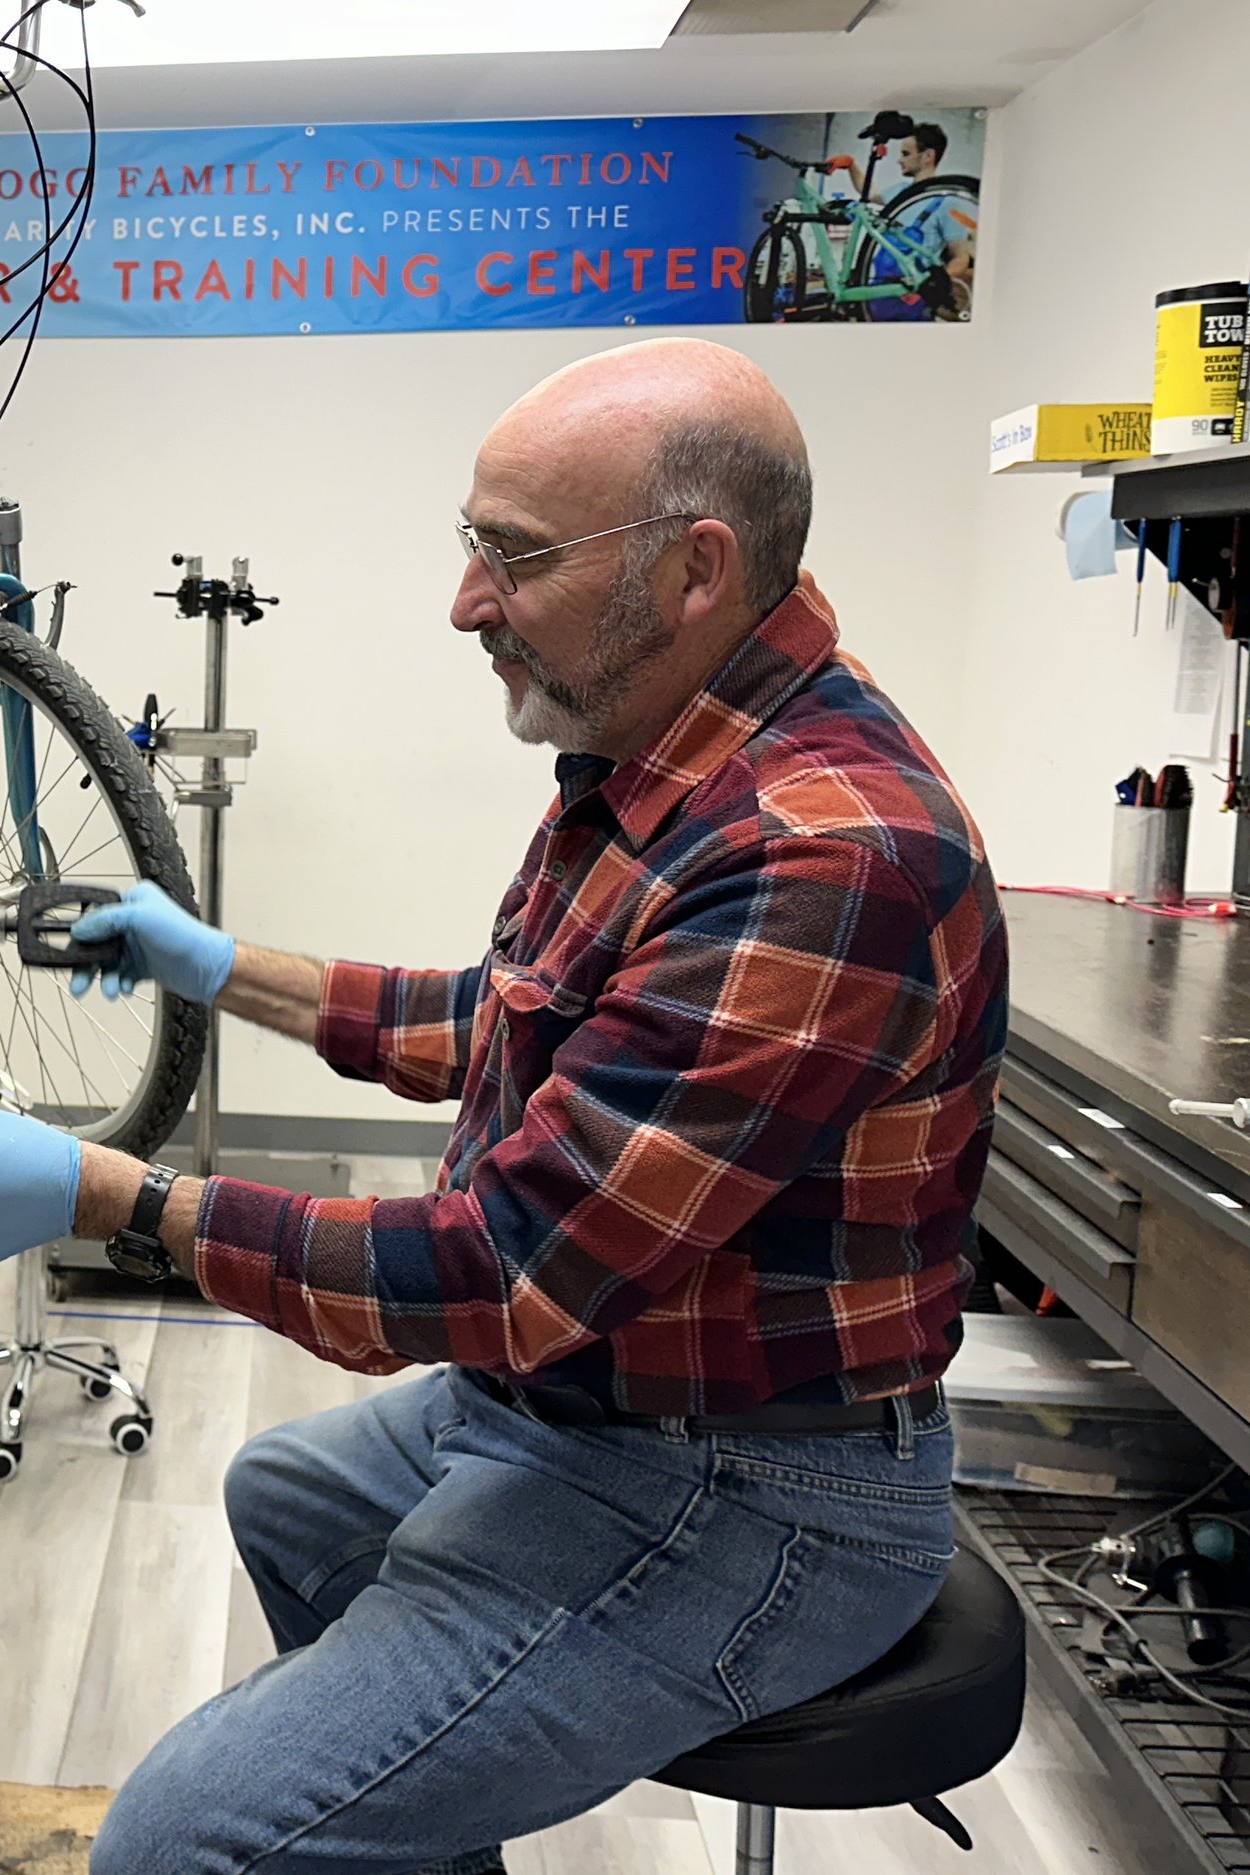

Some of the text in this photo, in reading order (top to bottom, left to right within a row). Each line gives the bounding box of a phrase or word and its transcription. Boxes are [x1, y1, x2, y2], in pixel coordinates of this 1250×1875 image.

[118, 161, 302, 199] FAMILY
[323, 151, 674, 192] FOUNDATION
[113, 214, 279, 241] BICYCLES,
[296, 210, 366, 236] INC.
[382, 206, 551, 233] PRESENTS
[568, 204, 630, 229] THE
[48, 262, 81, 304] &
[113, 252, 440, 301] TRAINING
[475, 246, 746, 296] CENTER
[1205, 315, 1244, 330] TUB
[1098, 411, 1152, 431] WHEAT
[1192, 420, 1208, 432] 90
[1232, 401, 1245, 444] HARDY
[1099, 429, 1152, 453] THINS
